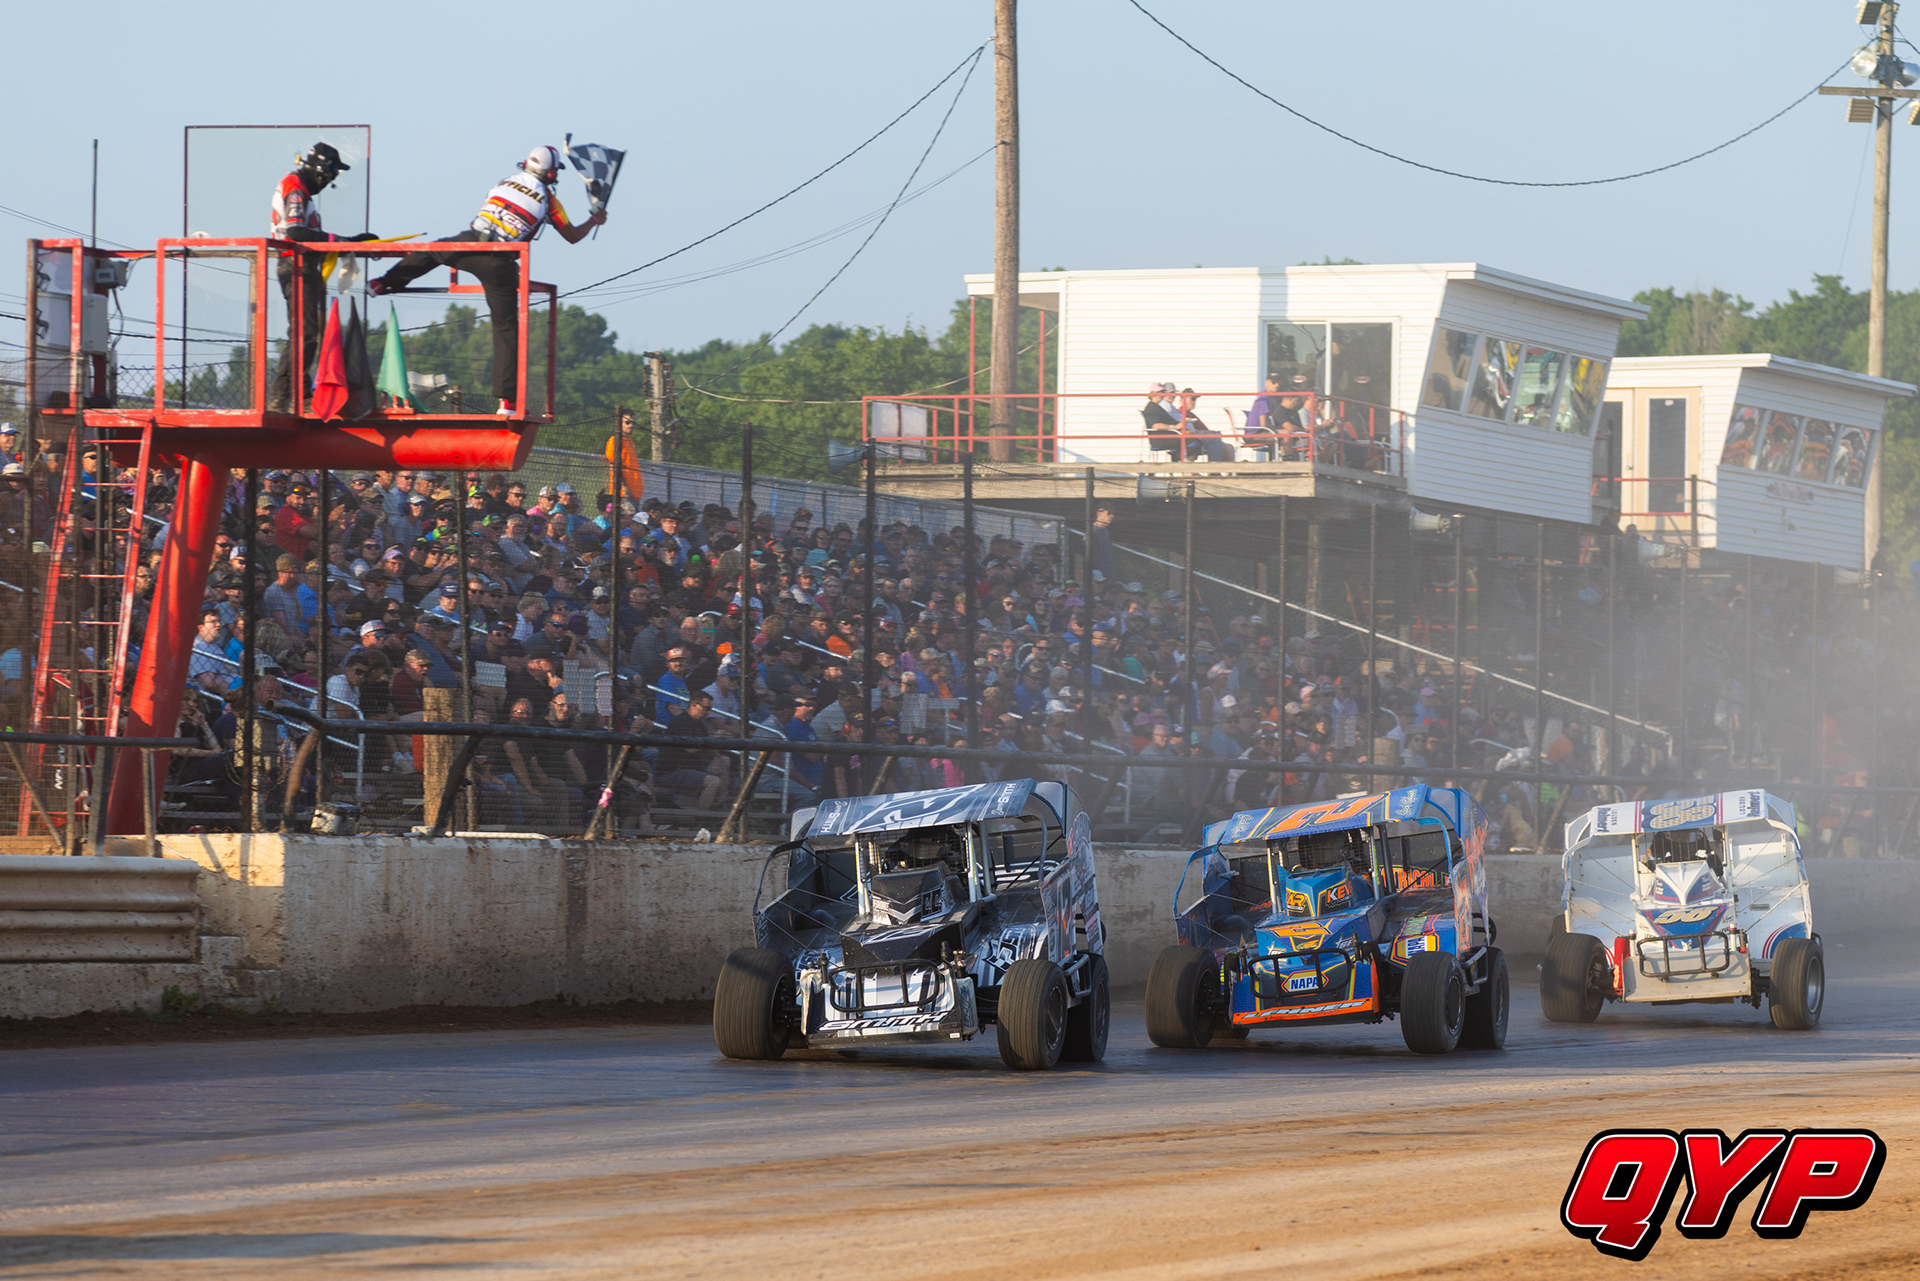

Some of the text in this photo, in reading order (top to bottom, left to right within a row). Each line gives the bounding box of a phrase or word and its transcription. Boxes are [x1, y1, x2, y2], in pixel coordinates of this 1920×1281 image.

[997, 783, 1017, 804] SMITH
[820, 811, 841, 833] SMITH
[1597, 807, 1610, 833] Reimert
[1649, 796, 1716, 829] 58
[1654, 906, 1719, 925] 58
[1290, 976, 1319, 990] NAPA
[819, 1011, 948, 1031] SMITH
